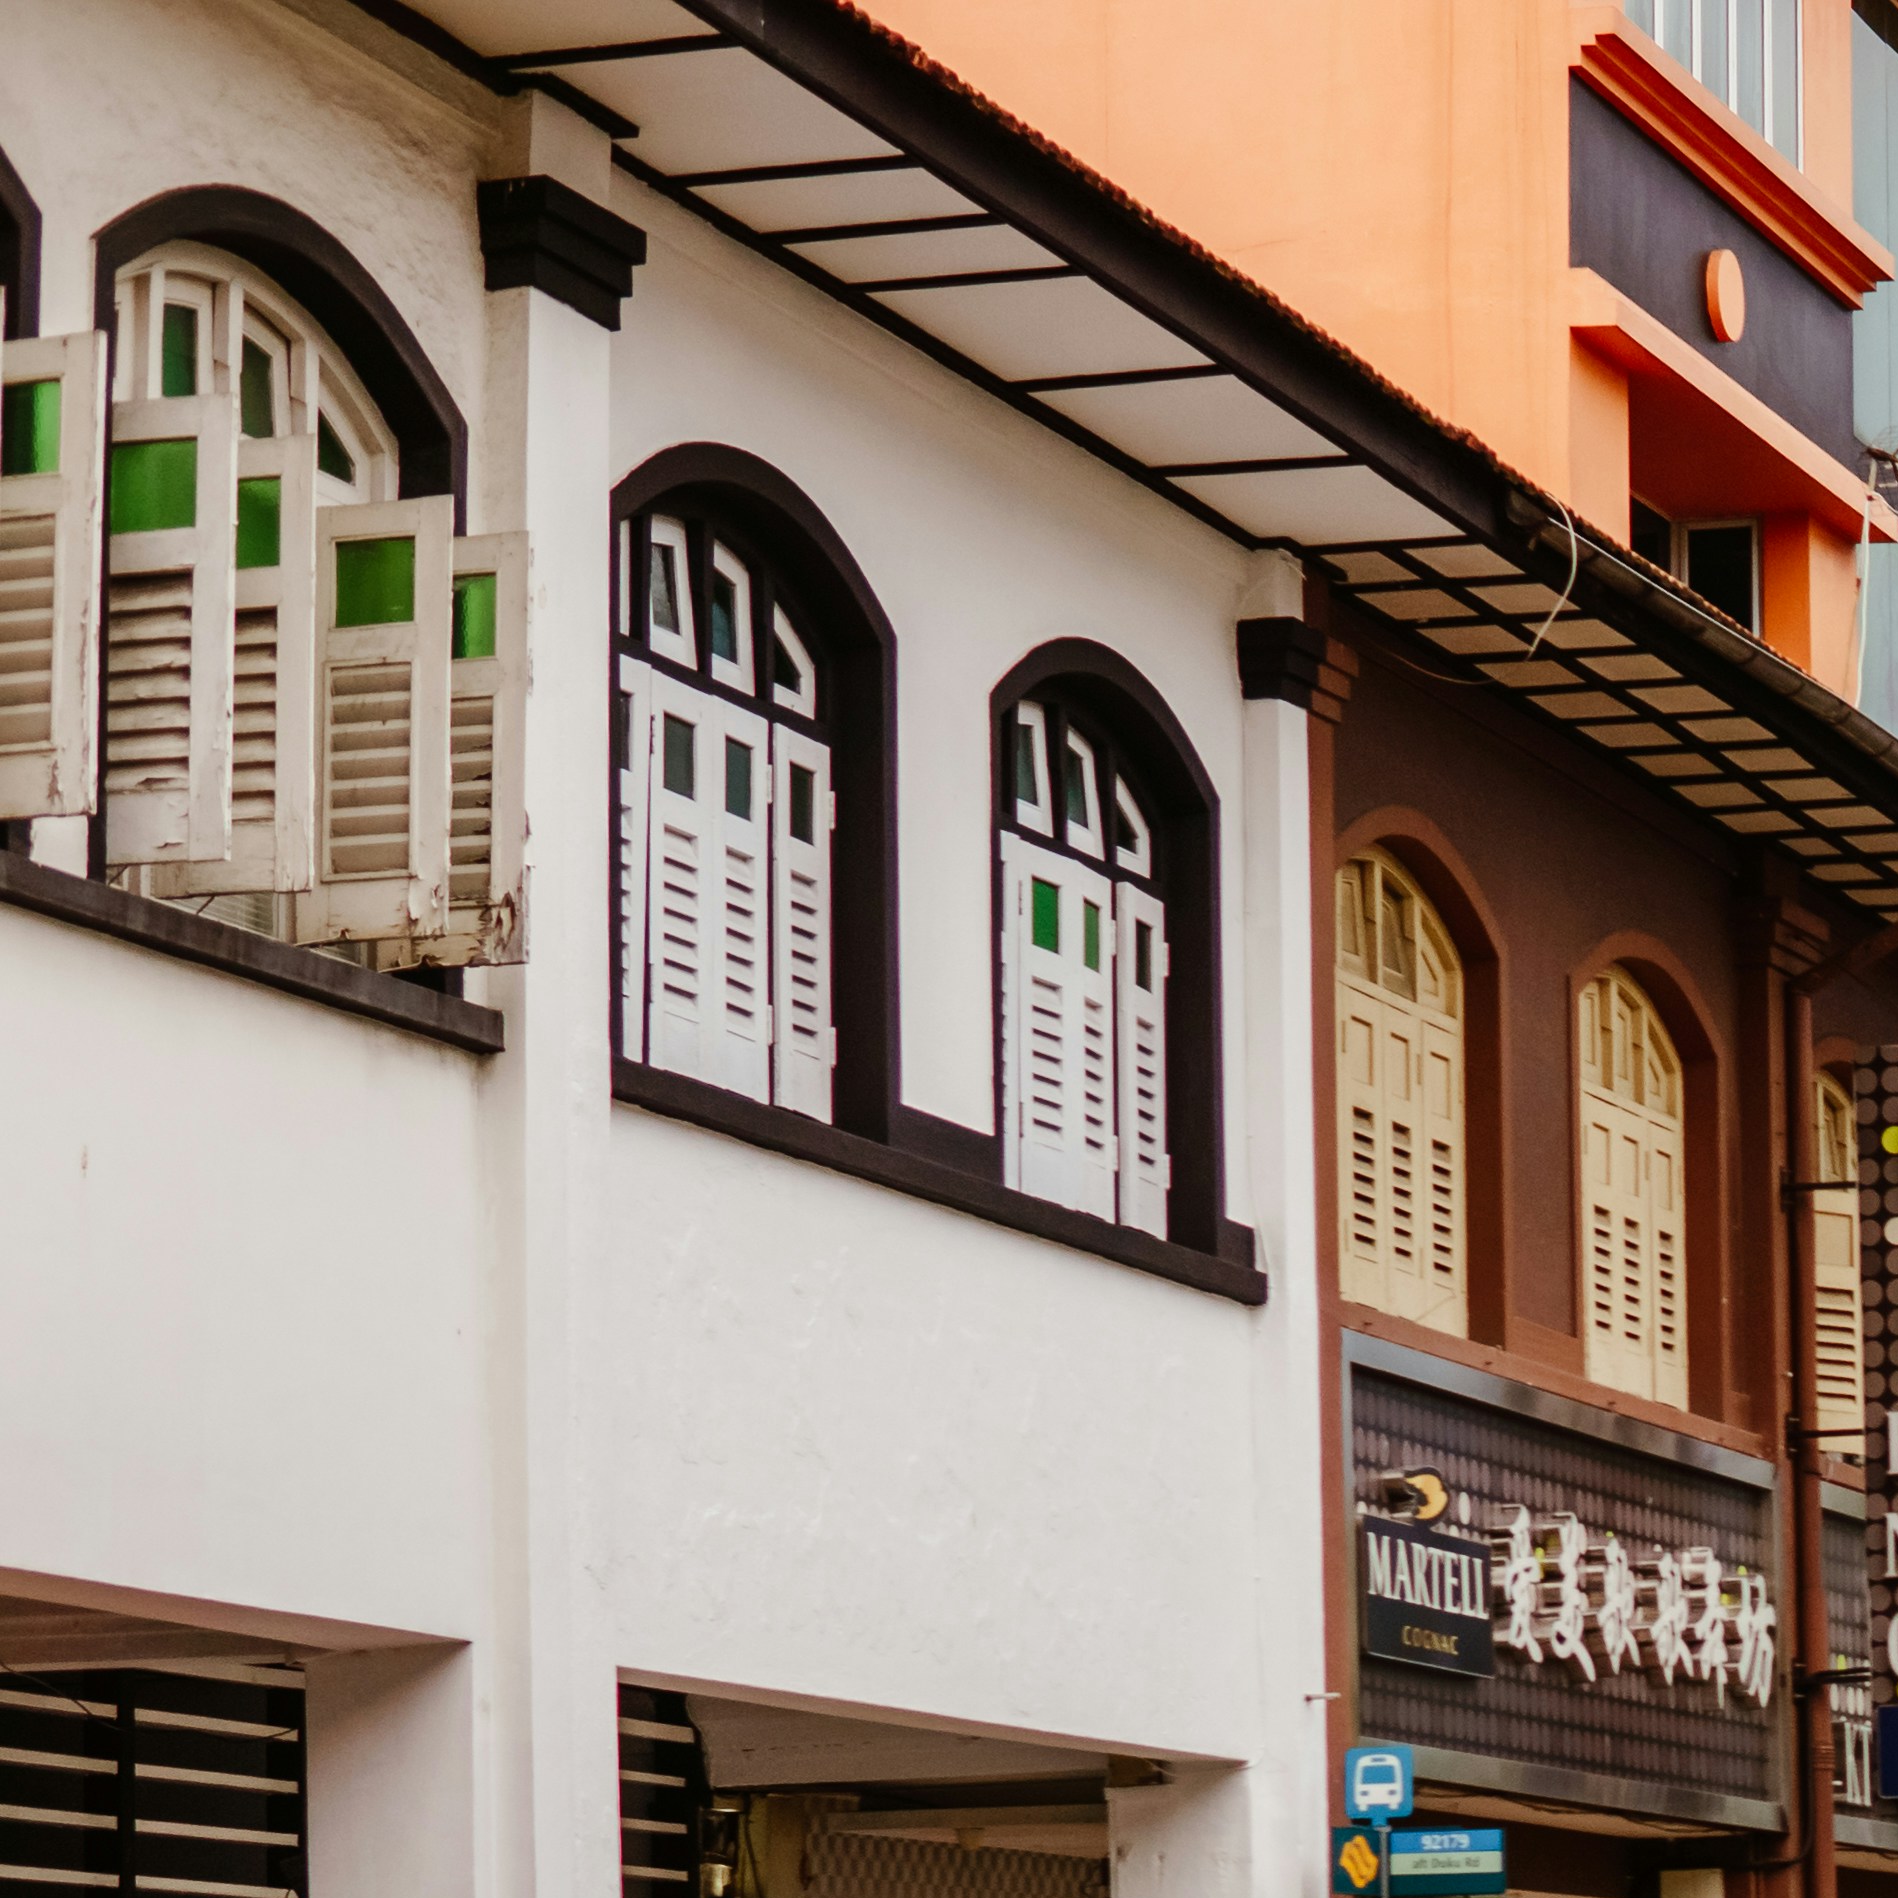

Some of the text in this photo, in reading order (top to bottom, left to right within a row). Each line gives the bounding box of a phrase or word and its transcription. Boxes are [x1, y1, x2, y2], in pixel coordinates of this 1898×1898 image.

[1366, 1531, 1490, 1621] MARTELL
[1401, 1624, 1460, 1657] COGNAC
[1420, 1833, 1470, 1850] 92179
